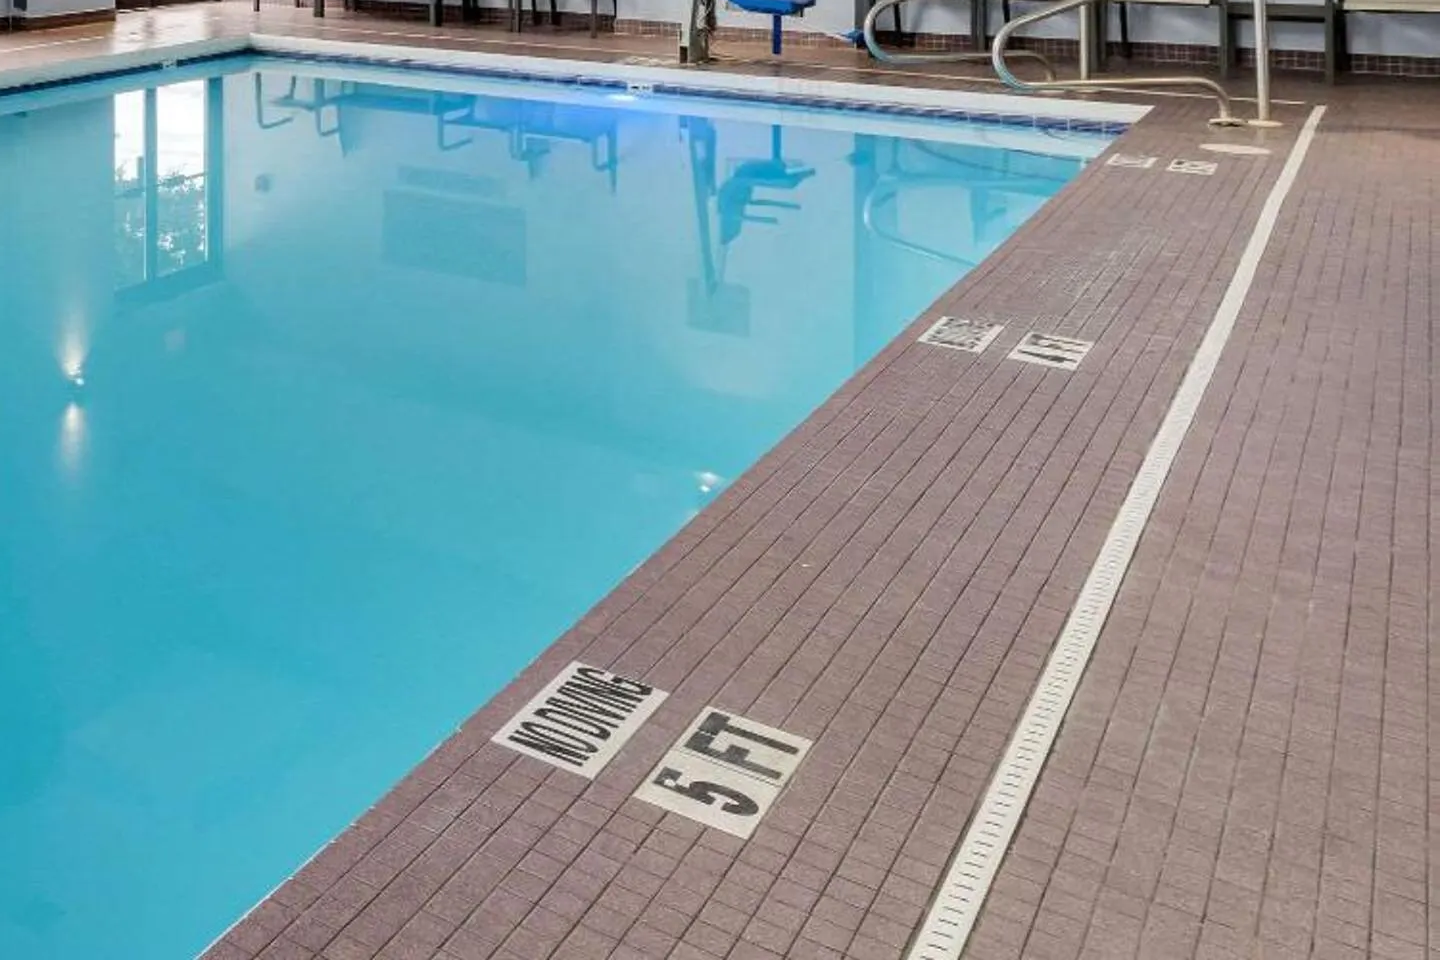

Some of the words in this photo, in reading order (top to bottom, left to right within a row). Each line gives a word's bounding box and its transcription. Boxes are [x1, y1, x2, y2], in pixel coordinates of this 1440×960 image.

[533, 666, 653, 741] DIVING
[508, 720, 599, 767] NO
[683, 711, 800, 780] FT
[652, 765, 759, 817] 5
